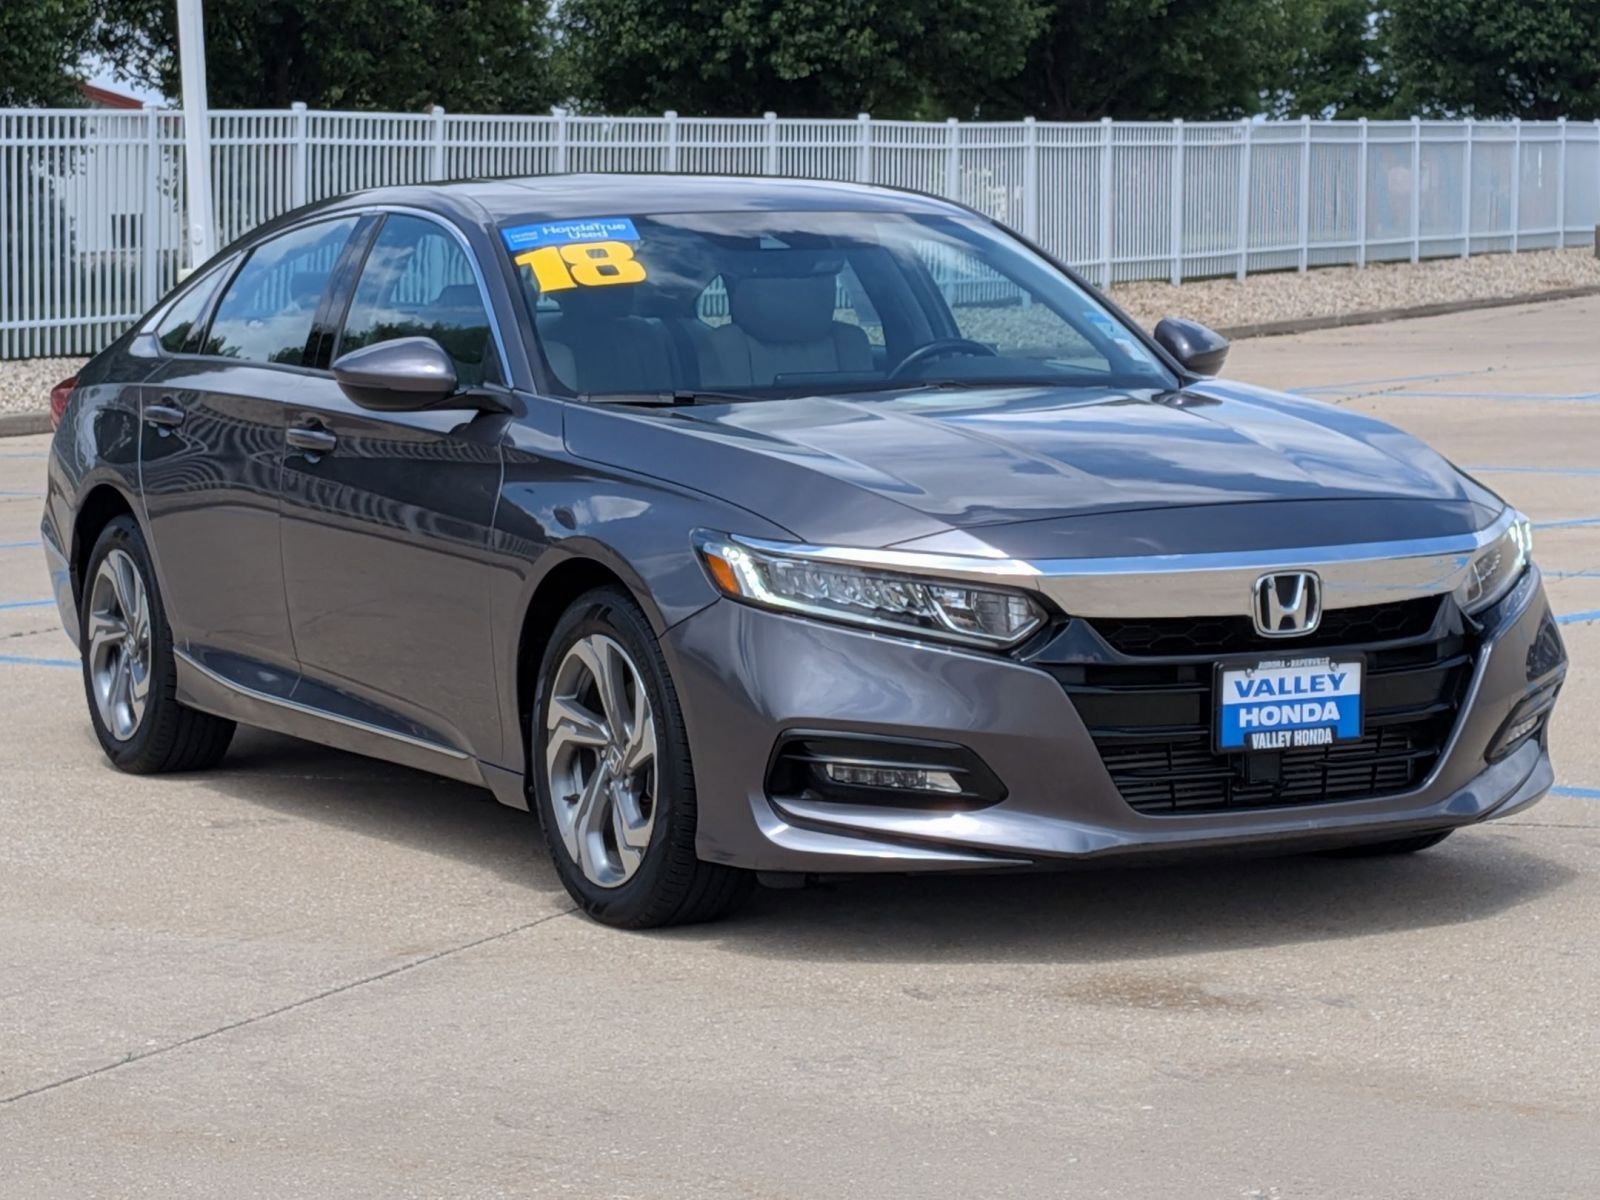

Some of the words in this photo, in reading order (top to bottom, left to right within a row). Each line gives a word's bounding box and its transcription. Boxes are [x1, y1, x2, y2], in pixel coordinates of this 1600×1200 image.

[514, 240, 647, 293] 18
[1234, 672, 1348, 699] VALLEY
[1239, 701, 1341, 728] HONDA
[1251, 730, 1293, 750] VALLEY
[1293, 727, 1333, 747] HONDA
